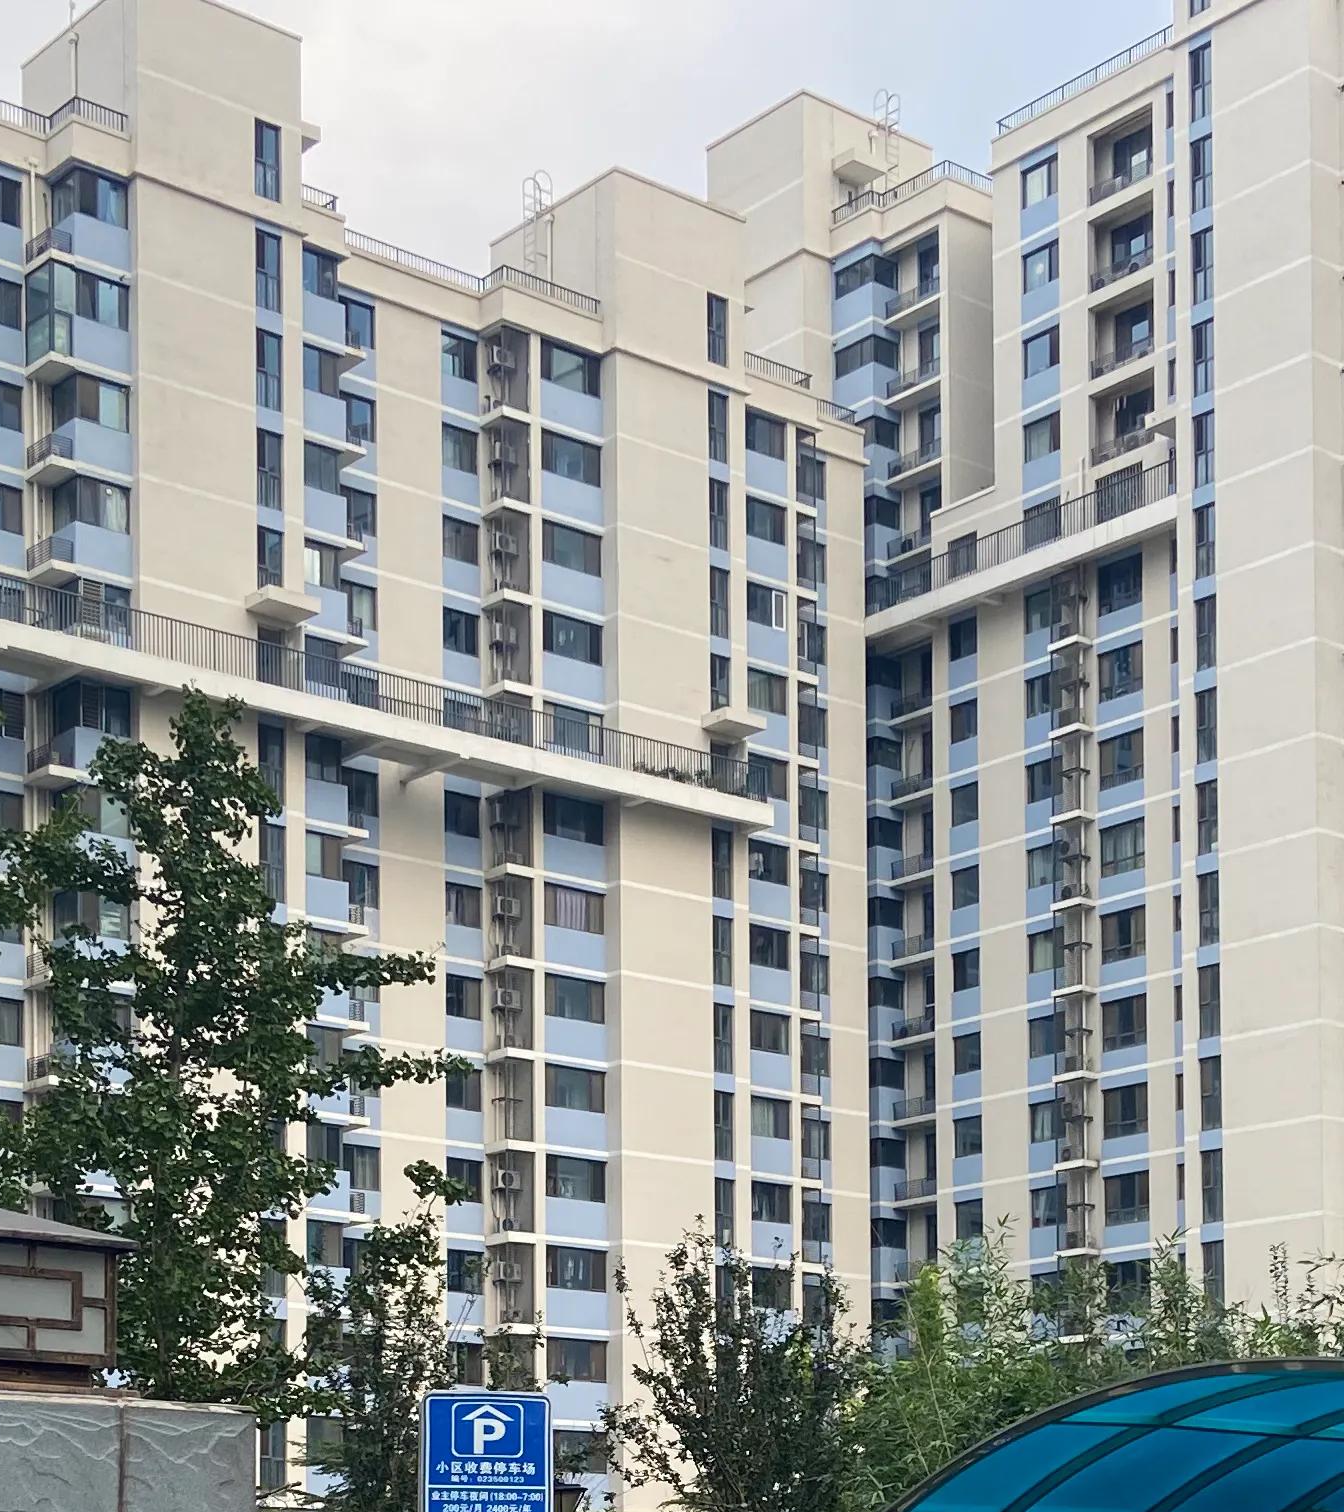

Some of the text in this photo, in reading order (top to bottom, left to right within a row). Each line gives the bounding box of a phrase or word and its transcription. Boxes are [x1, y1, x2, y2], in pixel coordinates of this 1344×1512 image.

[473, 1418, 507, 1455] P
[436, 1461, 536, 1475] 小区收费停车场
